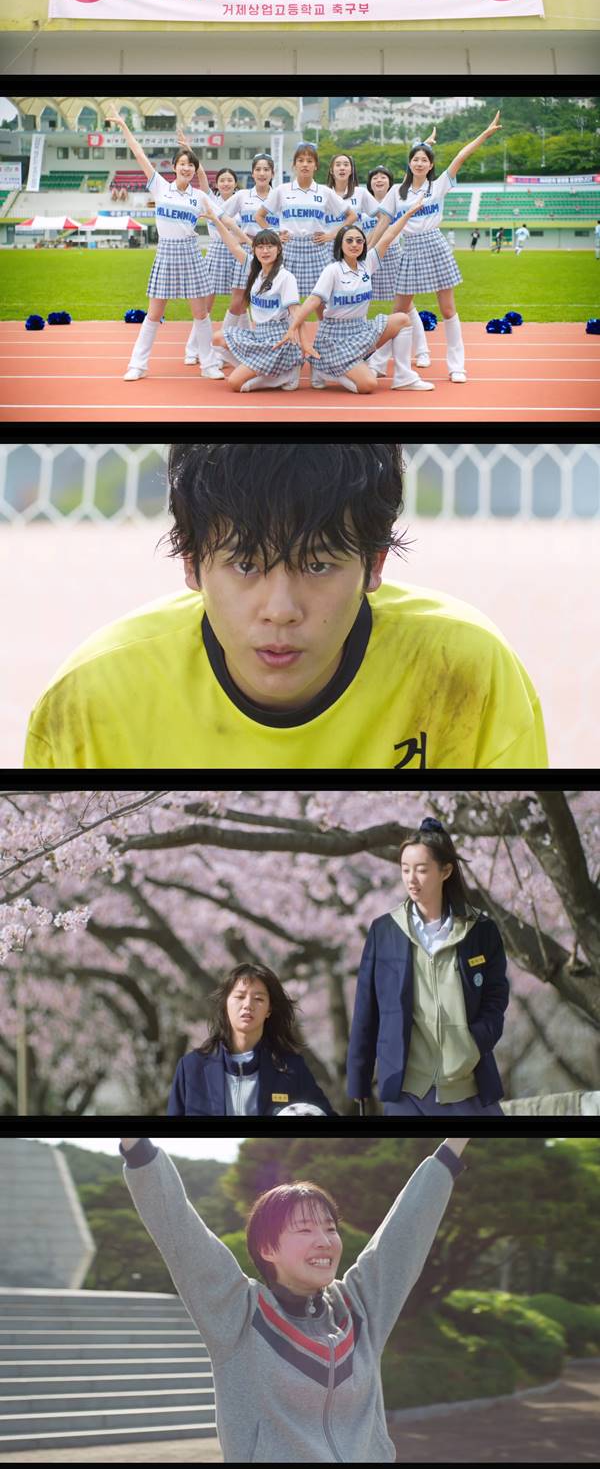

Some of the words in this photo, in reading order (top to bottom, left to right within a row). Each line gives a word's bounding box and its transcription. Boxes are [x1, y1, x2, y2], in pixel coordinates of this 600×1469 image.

[222, 2, 325, 16] 거제상업고등학교
[332, 2, 370, 15] 축구부
[313, 194, 323, 203] 10
[393, 731, 427, 769] 거
